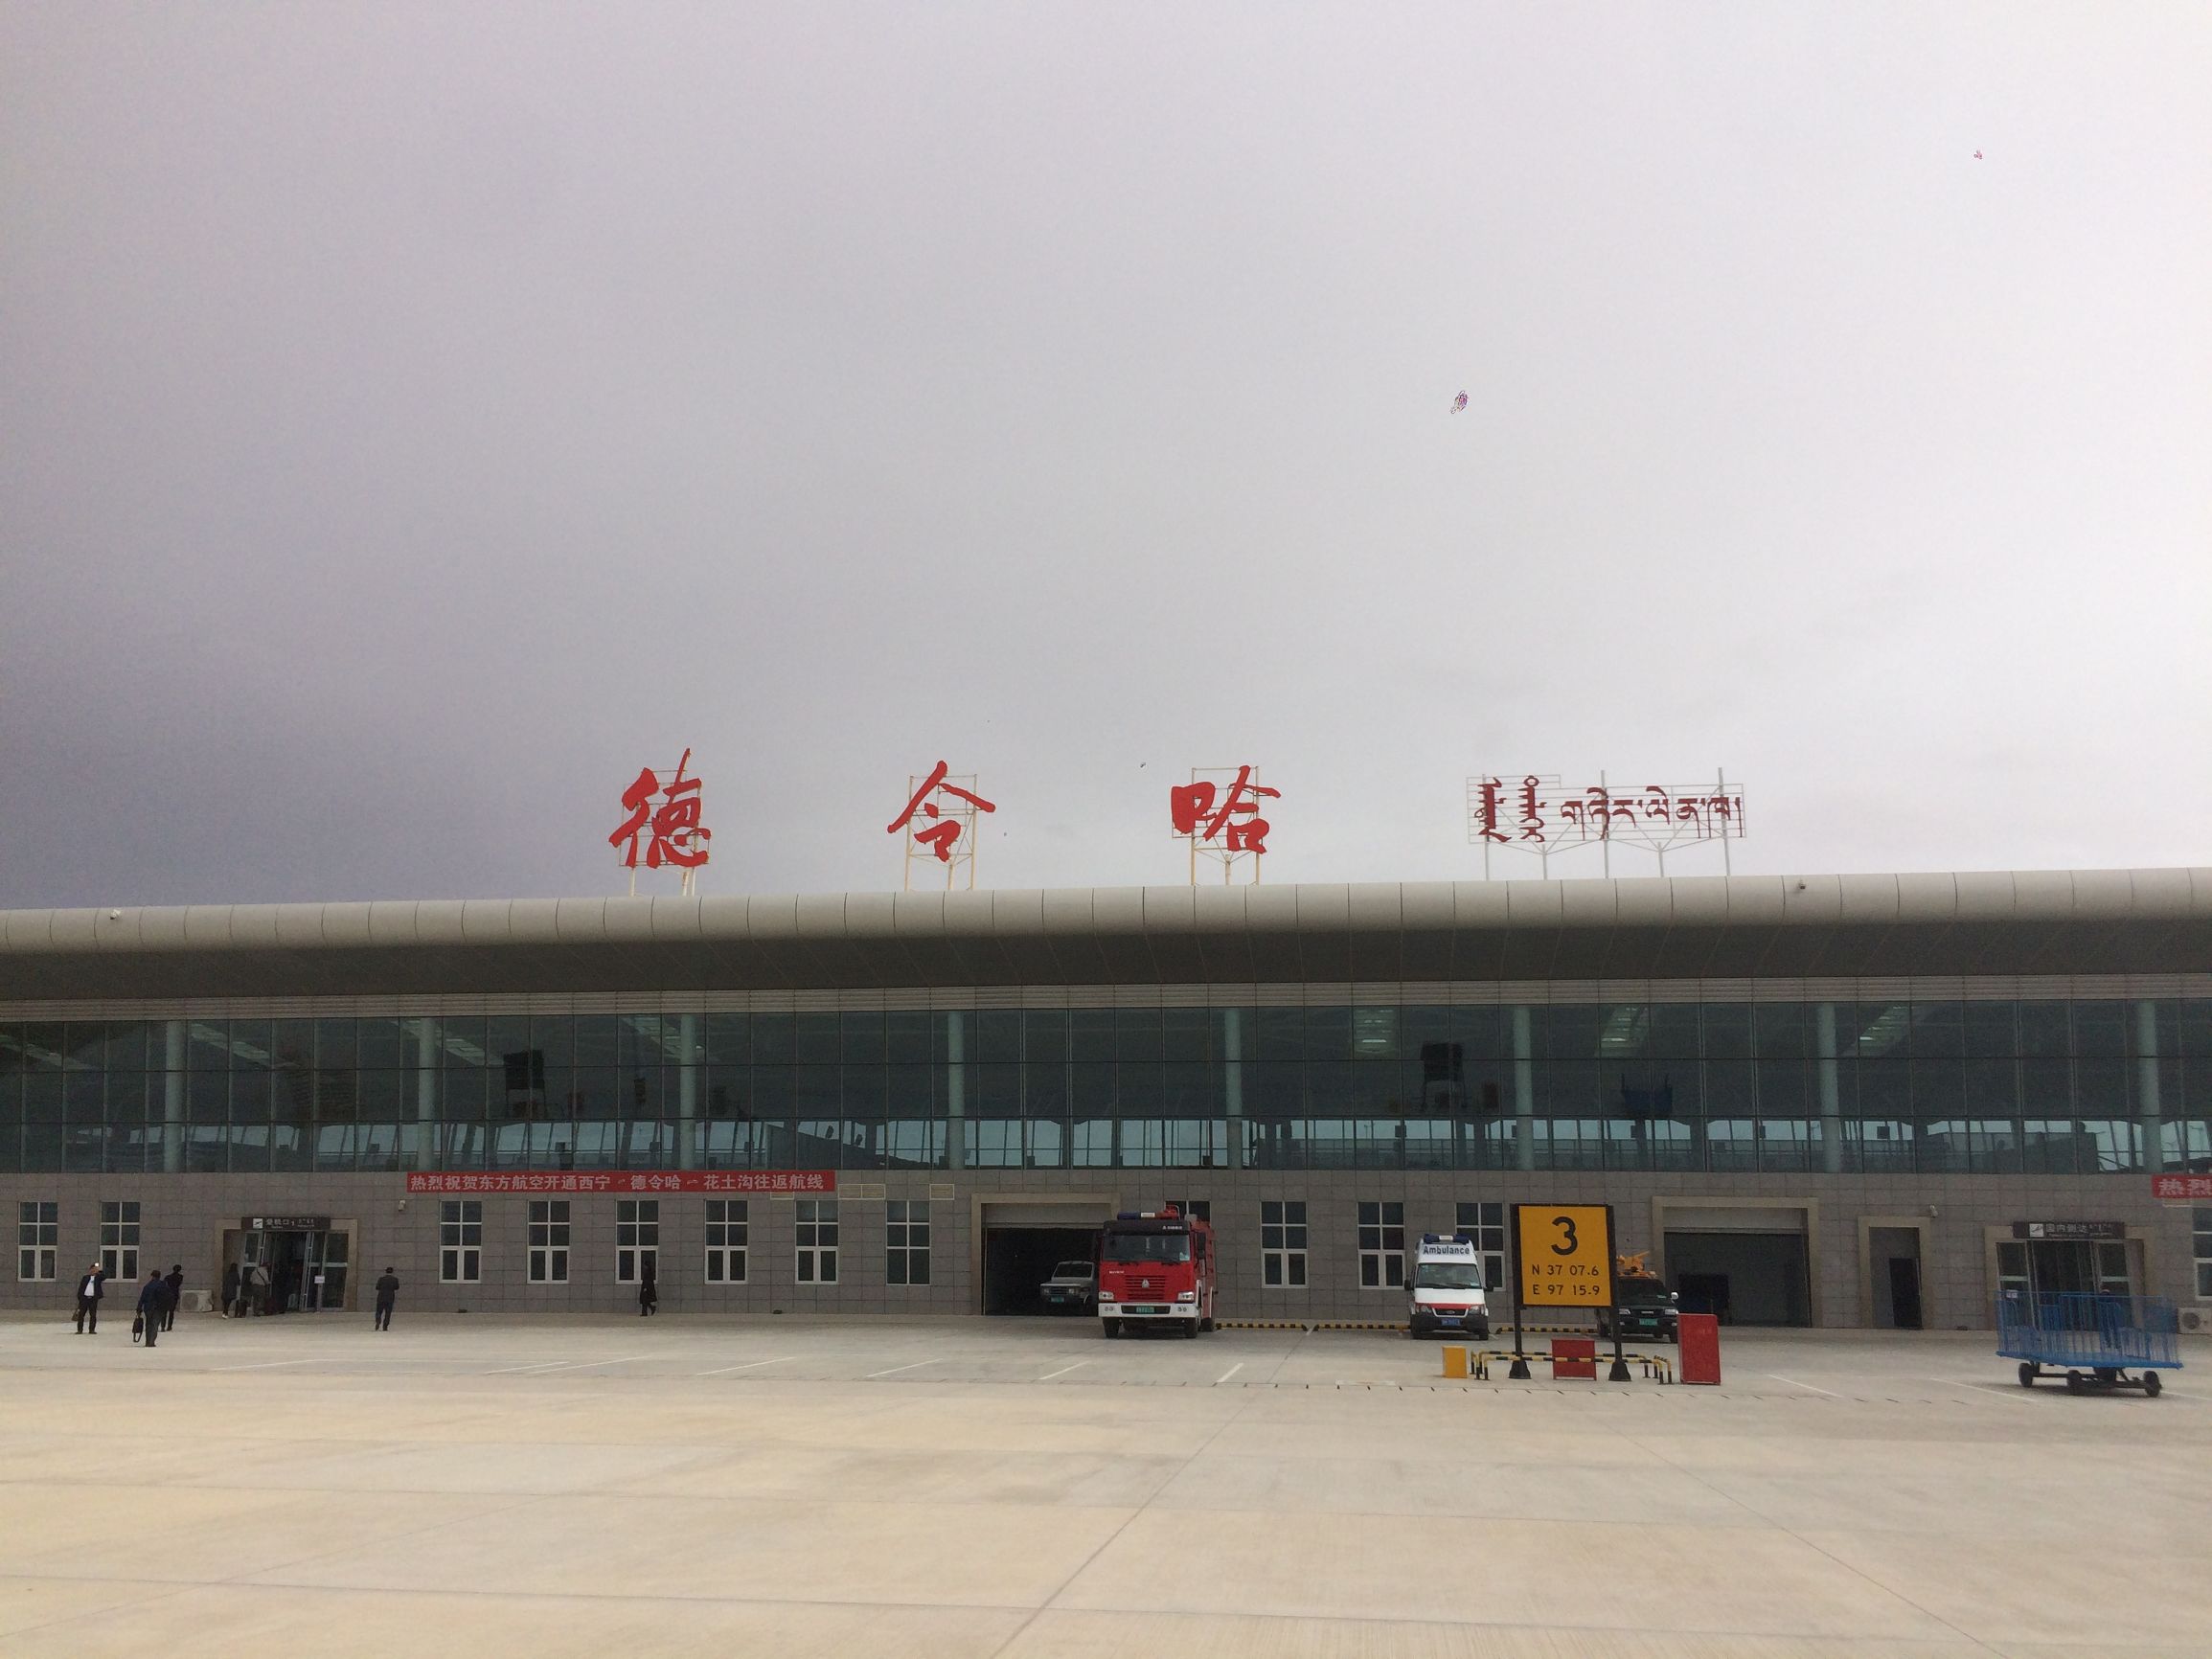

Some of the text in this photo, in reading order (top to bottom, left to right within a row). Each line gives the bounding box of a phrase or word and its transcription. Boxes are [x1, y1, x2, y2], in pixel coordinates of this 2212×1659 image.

[609, 748, 1281, 869] 德令哈
[2158, 1178, 2212, 1196] 热烈
[1551, 1216, 1578, 1256] 3
[1423, 1245, 1471, 1255] Ambulance
[1532, 1264, 1599, 1276] N 37 07.6
[1533, 1284, 1600, 1295] E 97 15.9
